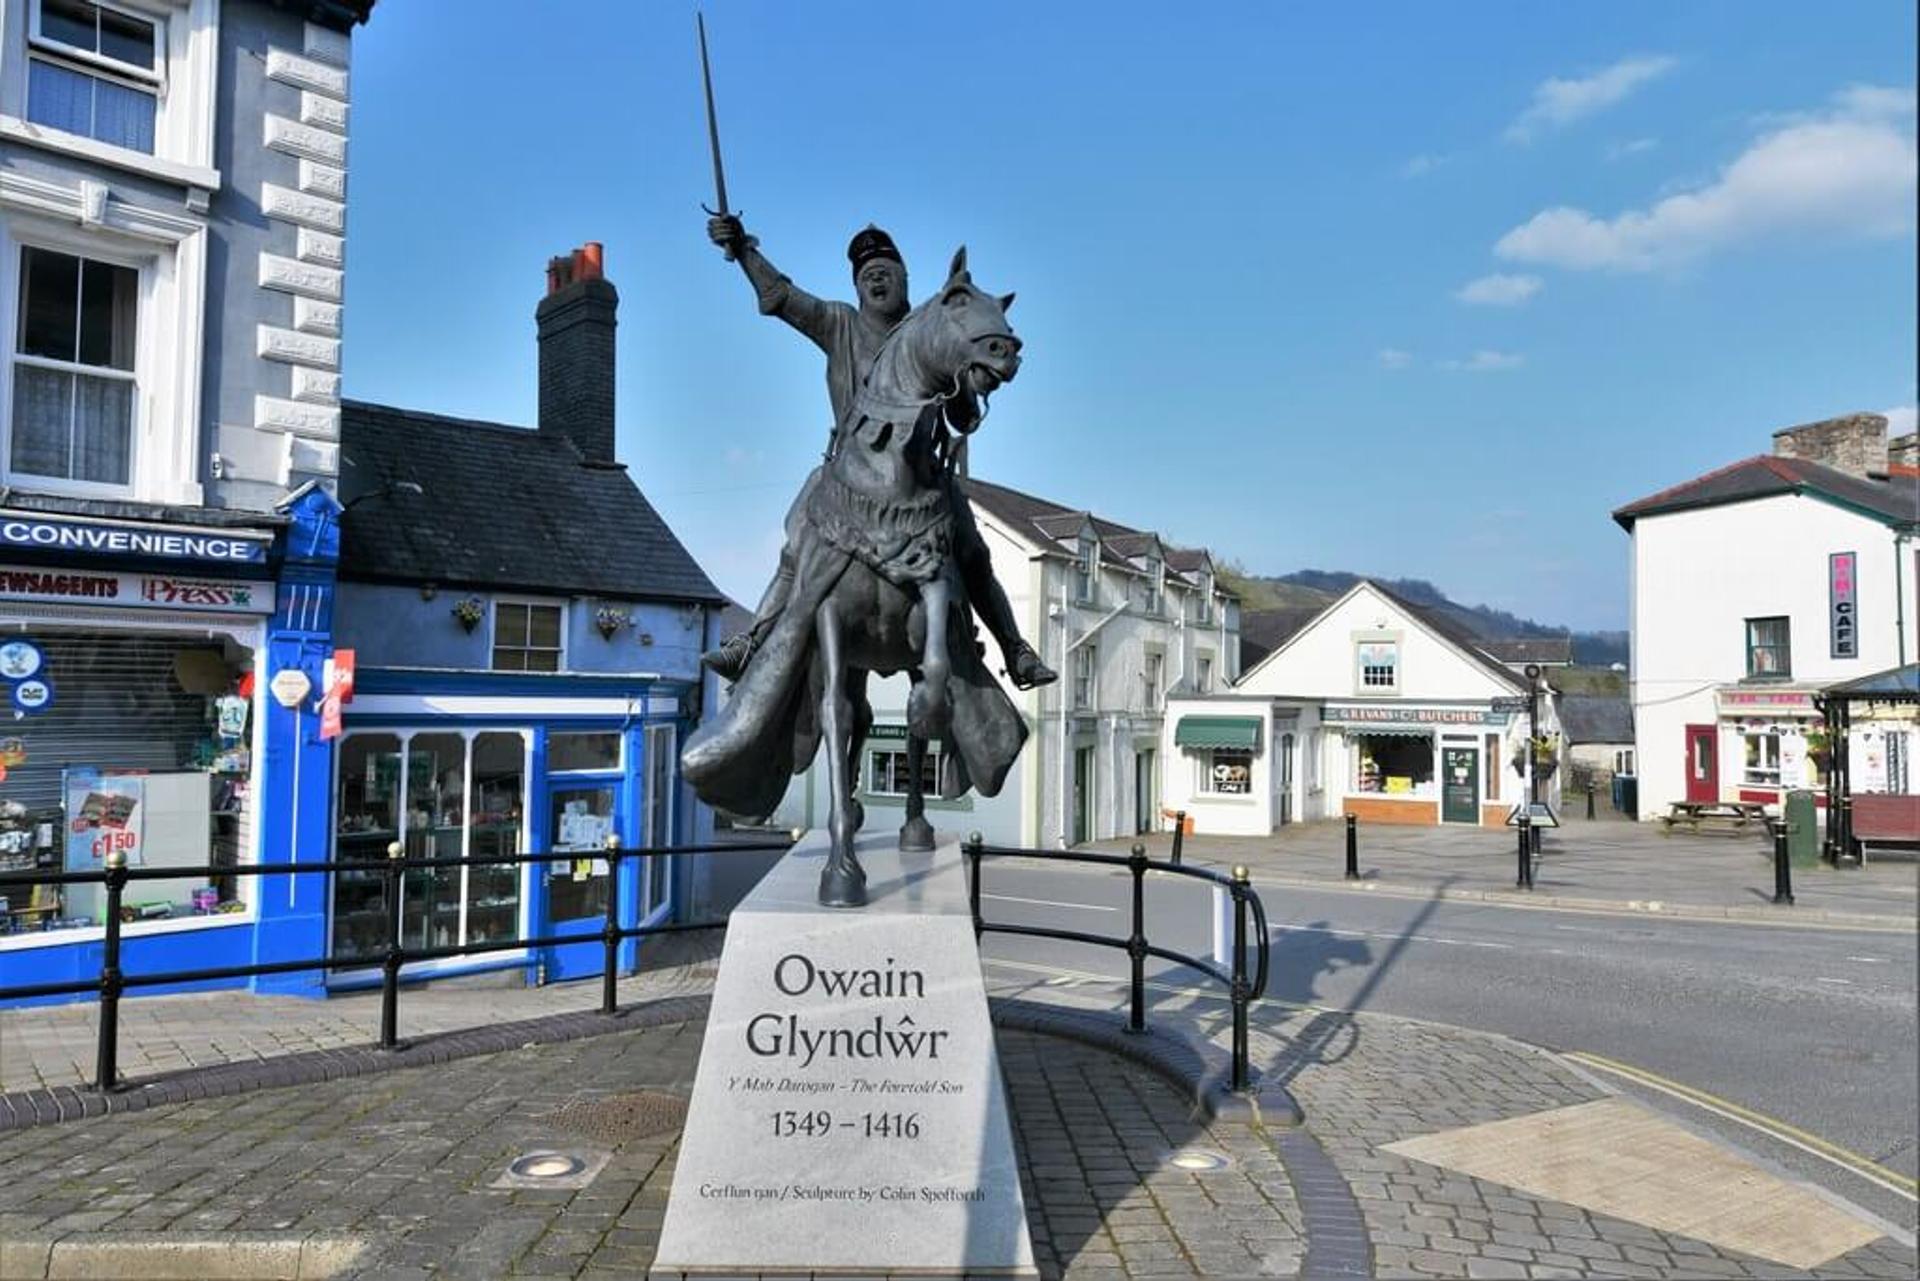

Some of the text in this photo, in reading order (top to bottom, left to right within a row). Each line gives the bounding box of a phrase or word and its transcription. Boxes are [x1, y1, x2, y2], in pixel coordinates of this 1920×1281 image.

[2, 522, 249, 559] CONVENIENCE
[1835, 602, 1853, 654] CAFE
[773, 953, 925, 998] Owain
[745, 1012, 949, 1069] Glyndŵr
[851, 1078, 878, 1093] The
[879, 1079, 938, 1094] Foretold
[937, 1080, 964, 1094] Son
[772, 1109, 832, 1138] 1349
[861, 1110, 920, 1139] 1416
[792, 1185, 856, 1201] Sculpture
[859, 1186, 876, 1202] by
[879, 1186, 917, 1201] Colin
